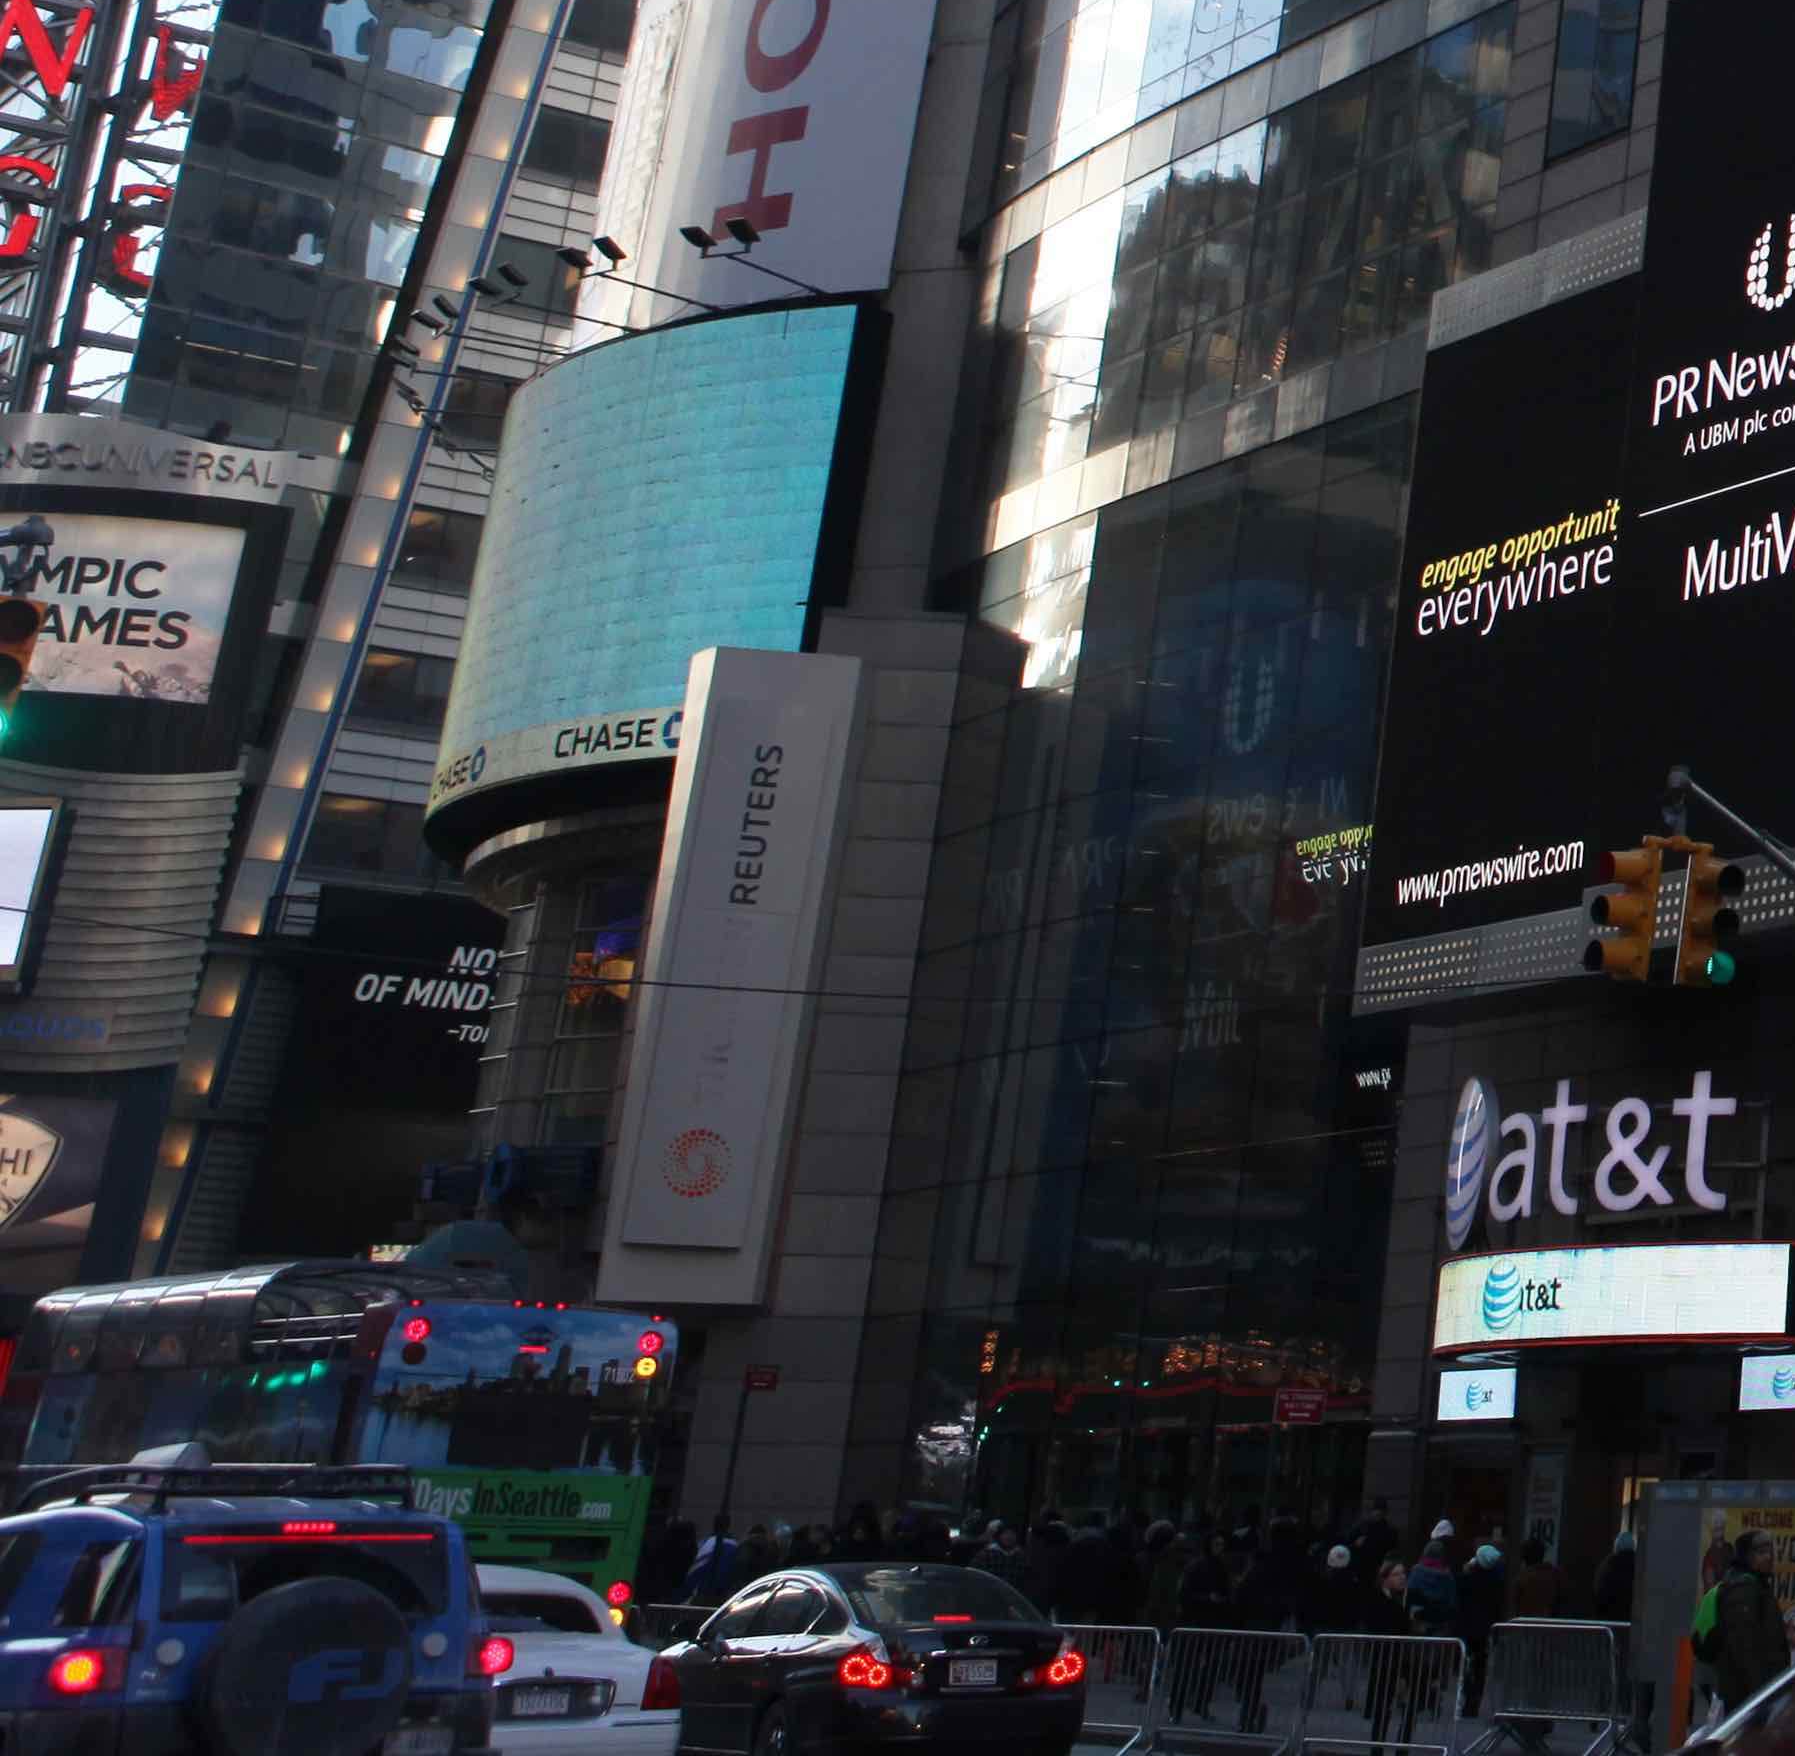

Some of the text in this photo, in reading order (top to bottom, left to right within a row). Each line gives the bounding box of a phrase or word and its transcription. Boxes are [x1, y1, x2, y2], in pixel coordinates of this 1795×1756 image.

[1652, 366, 1699, 427] PR
[1684, 432, 1696, 456] A
[1701, 418, 1739, 450] UBM
[1743, 409, 1768, 444] plc
[1417, 545, 1614, 636] everywhere
[1421, 544, 1497, 592] engage
[554, 717, 657, 758] CHASE
[728, 743, 784, 905] REUTERS
[1398, 840, 1584, 908] www.prnewswire.com
[354, 973, 402, 1004] OF
[1488, 1070, 1737, 1221] at&t
[411, 1476, 612, 1519] DaysInSeattle.com
